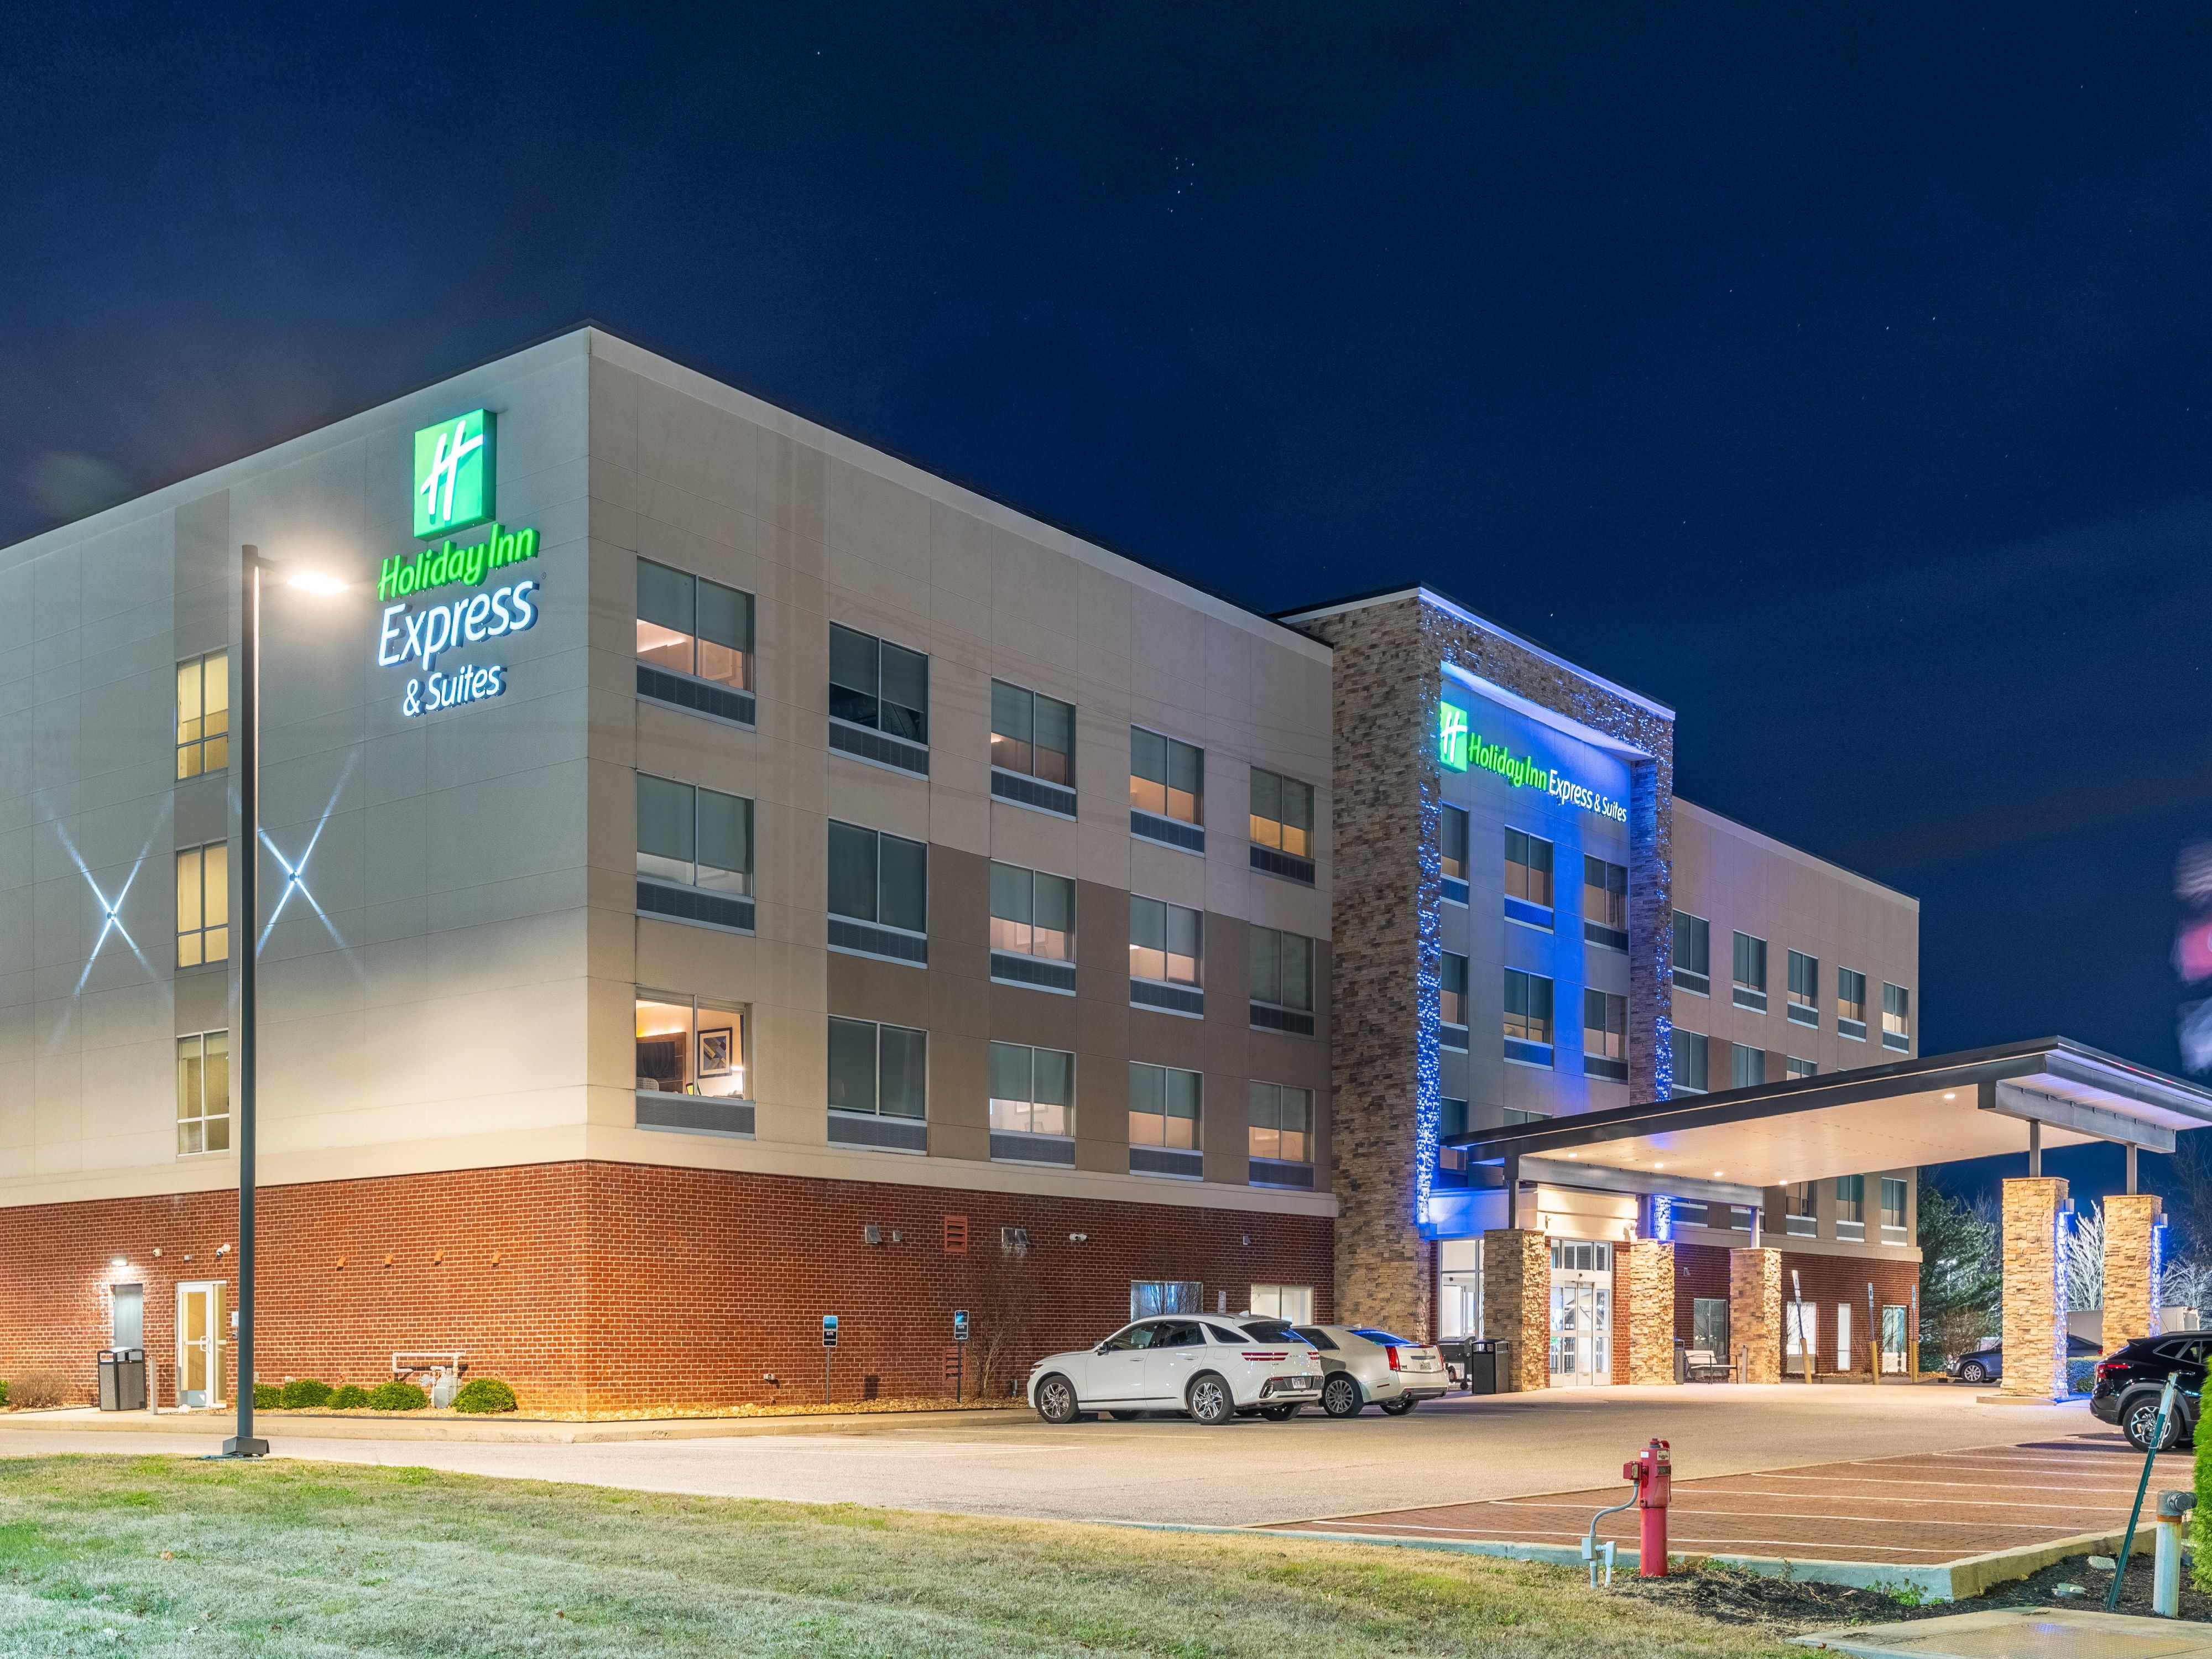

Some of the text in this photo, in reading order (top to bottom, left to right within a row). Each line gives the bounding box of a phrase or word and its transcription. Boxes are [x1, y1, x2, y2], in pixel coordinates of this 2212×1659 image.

[378, 523, 534, 602] Holiday Inn
[378, 580, 534, 671] Express
[403, 664, 500, 717] & Suites
[1468, 732, 1627, 823] Holiday Inn Express & Suites
